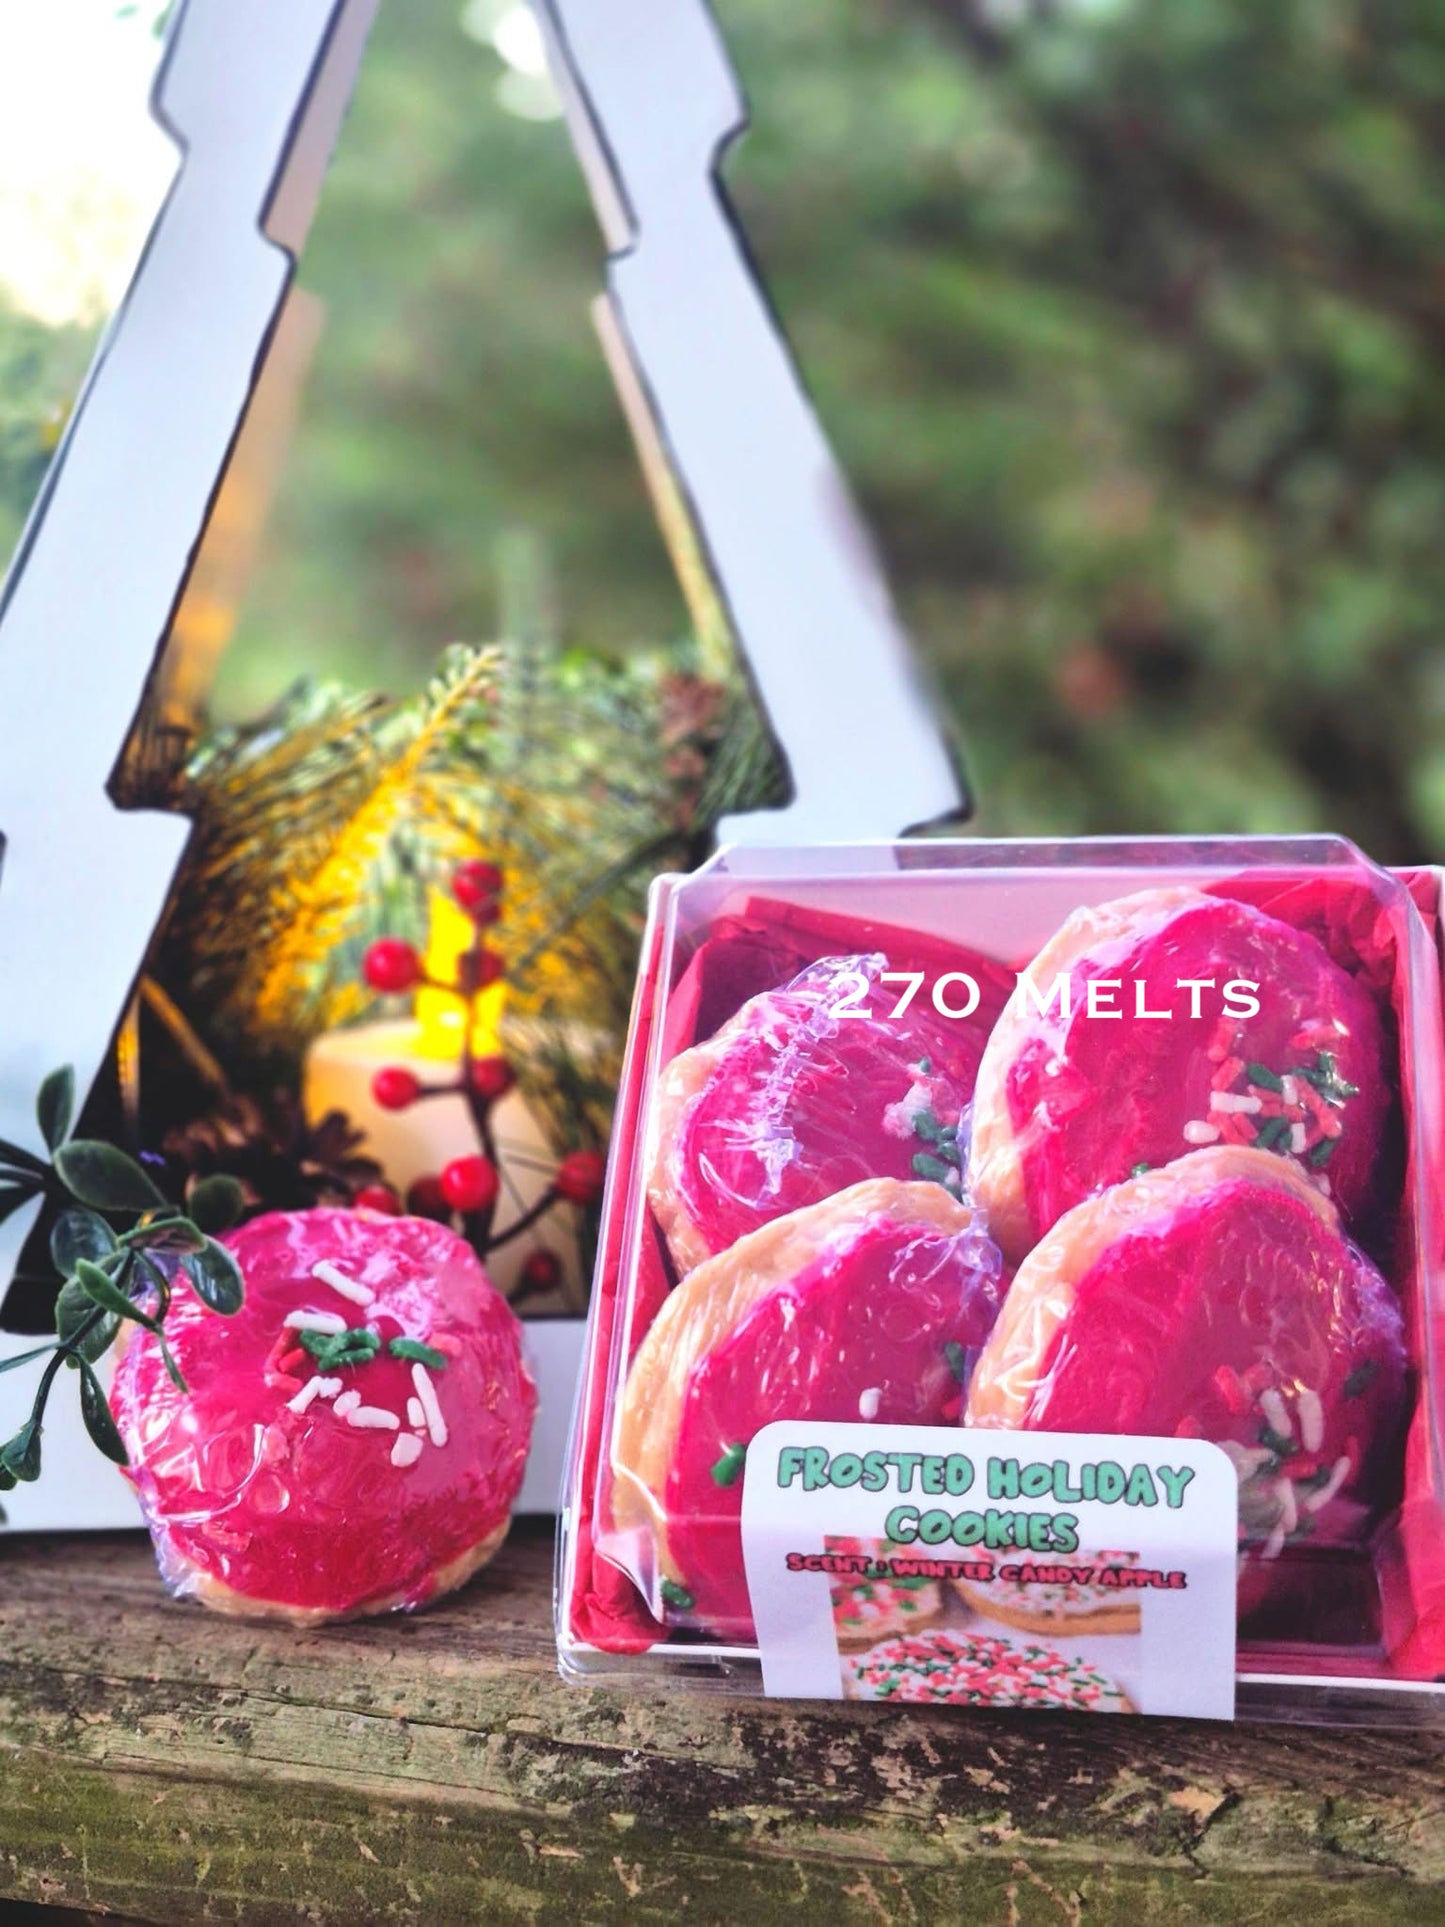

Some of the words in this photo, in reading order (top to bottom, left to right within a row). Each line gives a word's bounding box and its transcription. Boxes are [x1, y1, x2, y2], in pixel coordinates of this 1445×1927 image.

[777, 1446, 975, 1496] FROSTED
[986, 1457, 1195, 1509] HOLIDAY
[884, 1505, 1080, 1553] COOKIES
[786, 1553, 871, 1574] SCENT
[891, 1558, 996, 1581] WINTER
[1000, 1563, 1094, 1585] CANDY
[1099, 1567, 1188, 1589] APPLE
